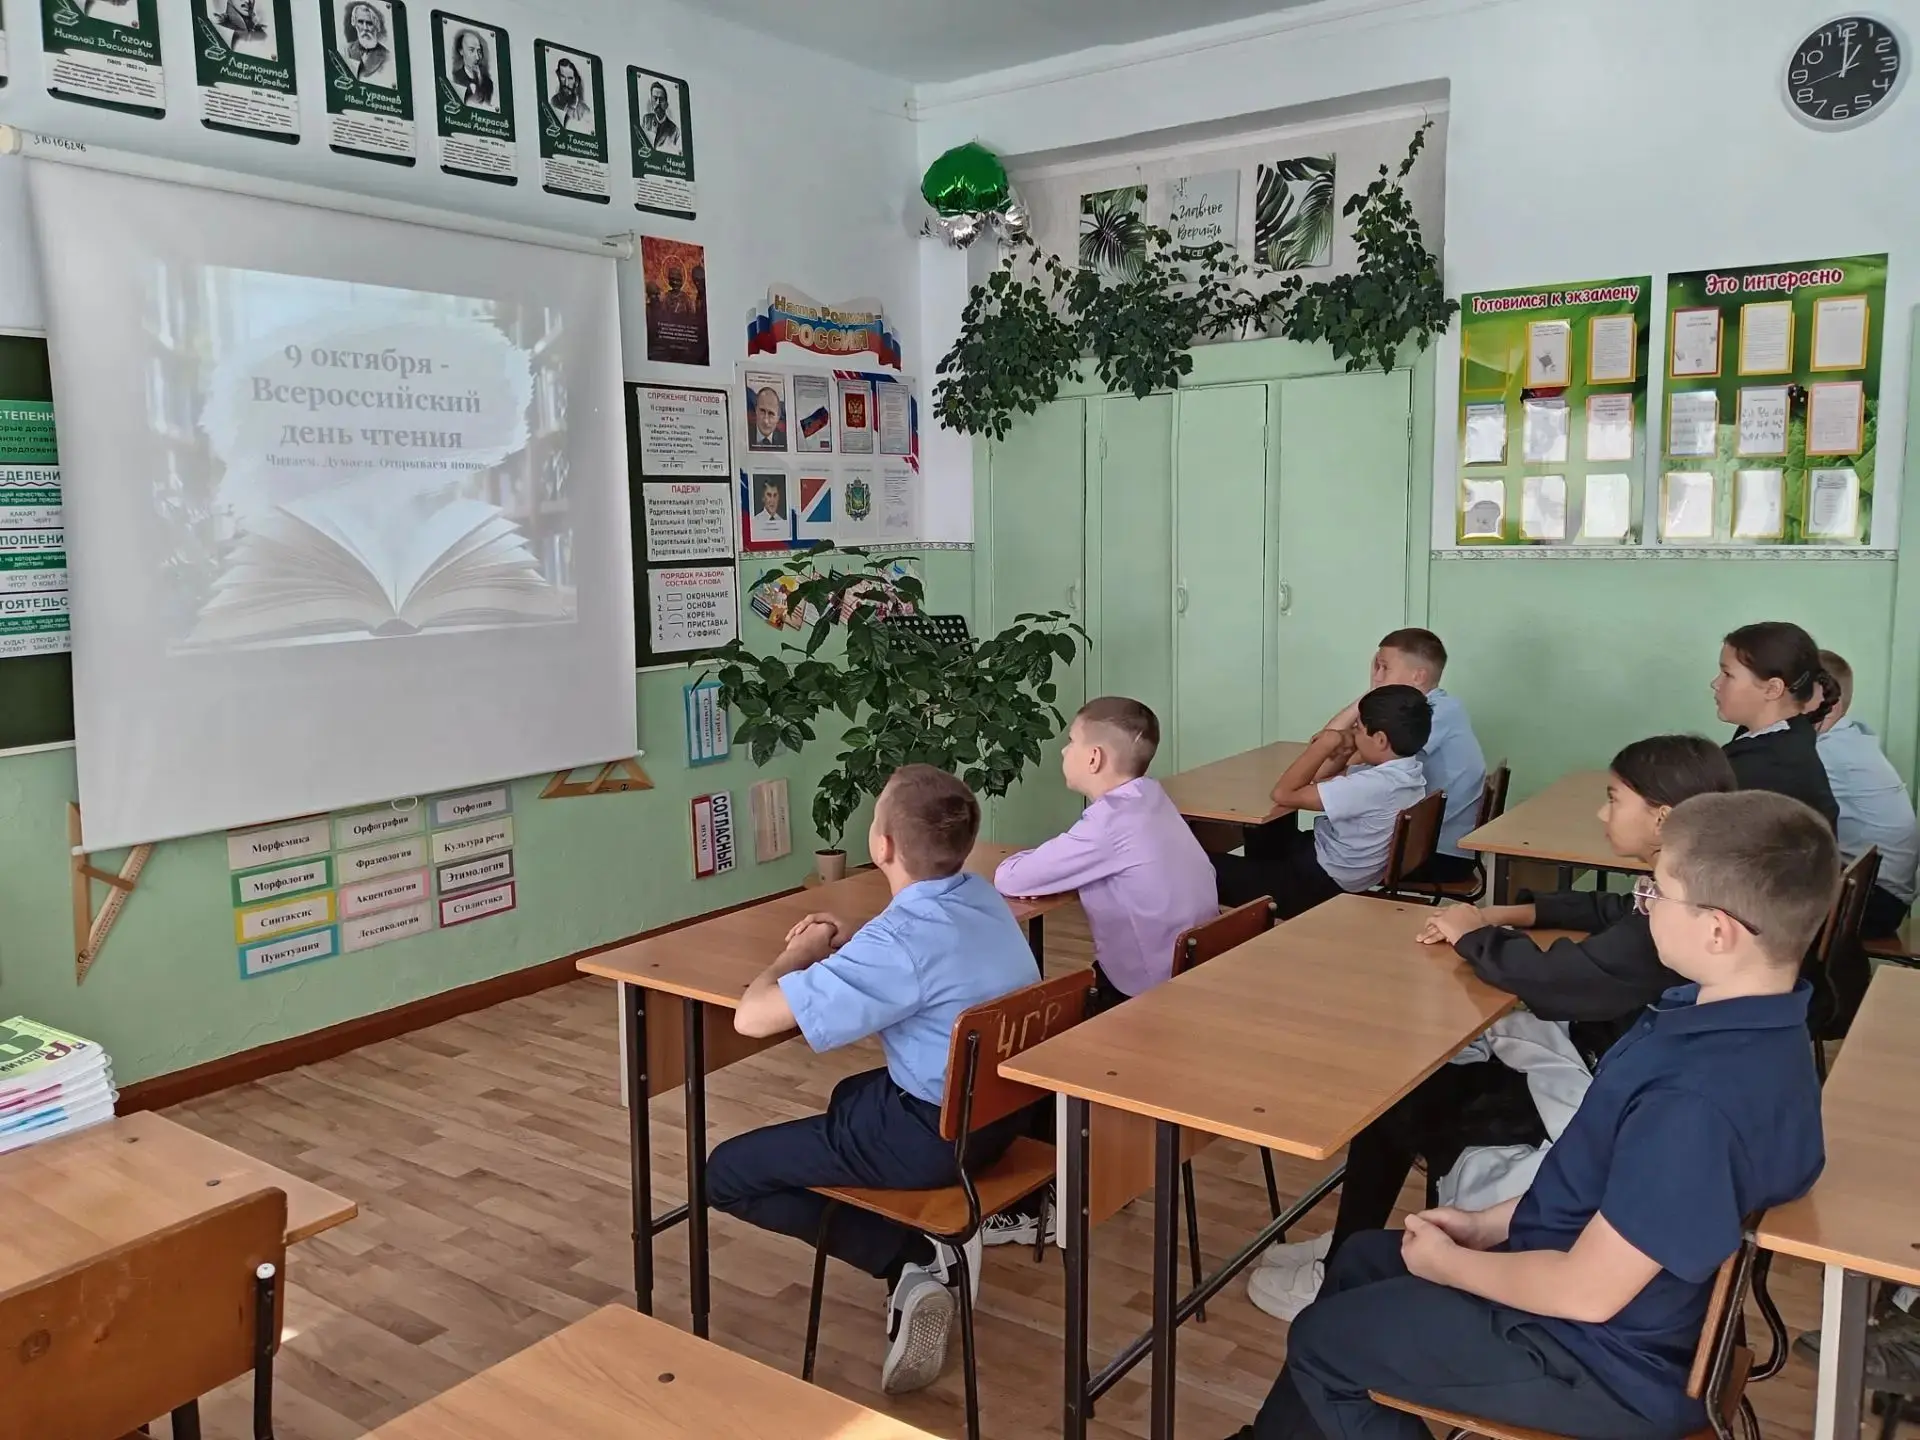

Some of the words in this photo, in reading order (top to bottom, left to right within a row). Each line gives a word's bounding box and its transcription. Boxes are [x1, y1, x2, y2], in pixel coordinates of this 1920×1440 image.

[112, 29, 153, 48] Гоголь
[1836, 21, 1858, 38] 12
[1867, 23, 1874, 38] 1
[54, 28, 94, 45] Николай
[97, 38, 154, 59] Васильевич
[1818, 32, 1832, 47] 11
[1875, 37, 1892, 53] 2
[1800, 50, 1823, 66] 10
[1880, 56, 1897, 72] 3
[228, 57, 289, 79] Лермонтов
[1792, 70, 1808, 84] 9
[220, 66, 252, 80] Михаил
[254, 74, 290, 89] Юрьевич
[1872, 78, 1890, 91] 4
[345, 94, 364, 105] Иван
[365, 100, 403, 114] Сергеевич
[359, 86, 402, 105] Тургенев
[1796, 88, 1813, 103] 8
[1855, 94, 1872, 110] 5
[1813, 99, 1827, 116] 7
[1832, 104, 1849, 119] 6
[444, 116, 471, 129] Николай
[471, 112, 509, 129] Некрасов
[568, 134, 599, 149] Толстой
[1706, 273, 1738, 295] Это
[1743, 267, 1844, 294] интересно
[1472, 293, 1548, 315] Готовимся
[1551, 293, 1561, 307] к
[1565, 285, 1640, 305] экзамену
[774, 294, 818, 321] Наша
[821, 305, 874, 326] Родина
[785, 318, 870, 351] РОССИЯ
[284, 344, 302, 369] 9
[311, 347, 433, 380] октября
[251, 375, 482, 414] Всероссийский
[647, 392, 688, 401] СПРЯЖЕНИЕ
[689, 394, 720, 404] ГЛАГОЛОВ
[279, 423, 354, 448] день
[360, 427, 464, 449] чтения
[379, 458, 448, 472] Открываем
[671, 485, 701, 494] ПАДЕЖИ
[686, 591, 729, 600] ОКОНЧАНИЕ
[686, 601, 716, 609] ОСНОВА
[686, 611, 715, 619] КОРЕНЬ
[687, 619, 728, 629] ПРИСТАВКА
[687, 629, 721, 638] СУФФИКС
[353, 815, 409, 836] Орфография
[713, 795, 732, 871] СОГЛАСНЫЕ
[252, 835, 310, 854] Морфемика
[444, 837, 484, 852] Культура
[355, 849, 412, 869] Фразеология
[447, 861, 504, 883] Этимология
[253, 873, 315, 893] Морфология
[355, 881, 417, 904] Акцентология
[453, 894, 503, 914] Стилистика
[260, 908, 313, 928] Синтаксис
[358, 916, 419, 939] Лексикология
[260, 941, 320, 964] Пунктуация
